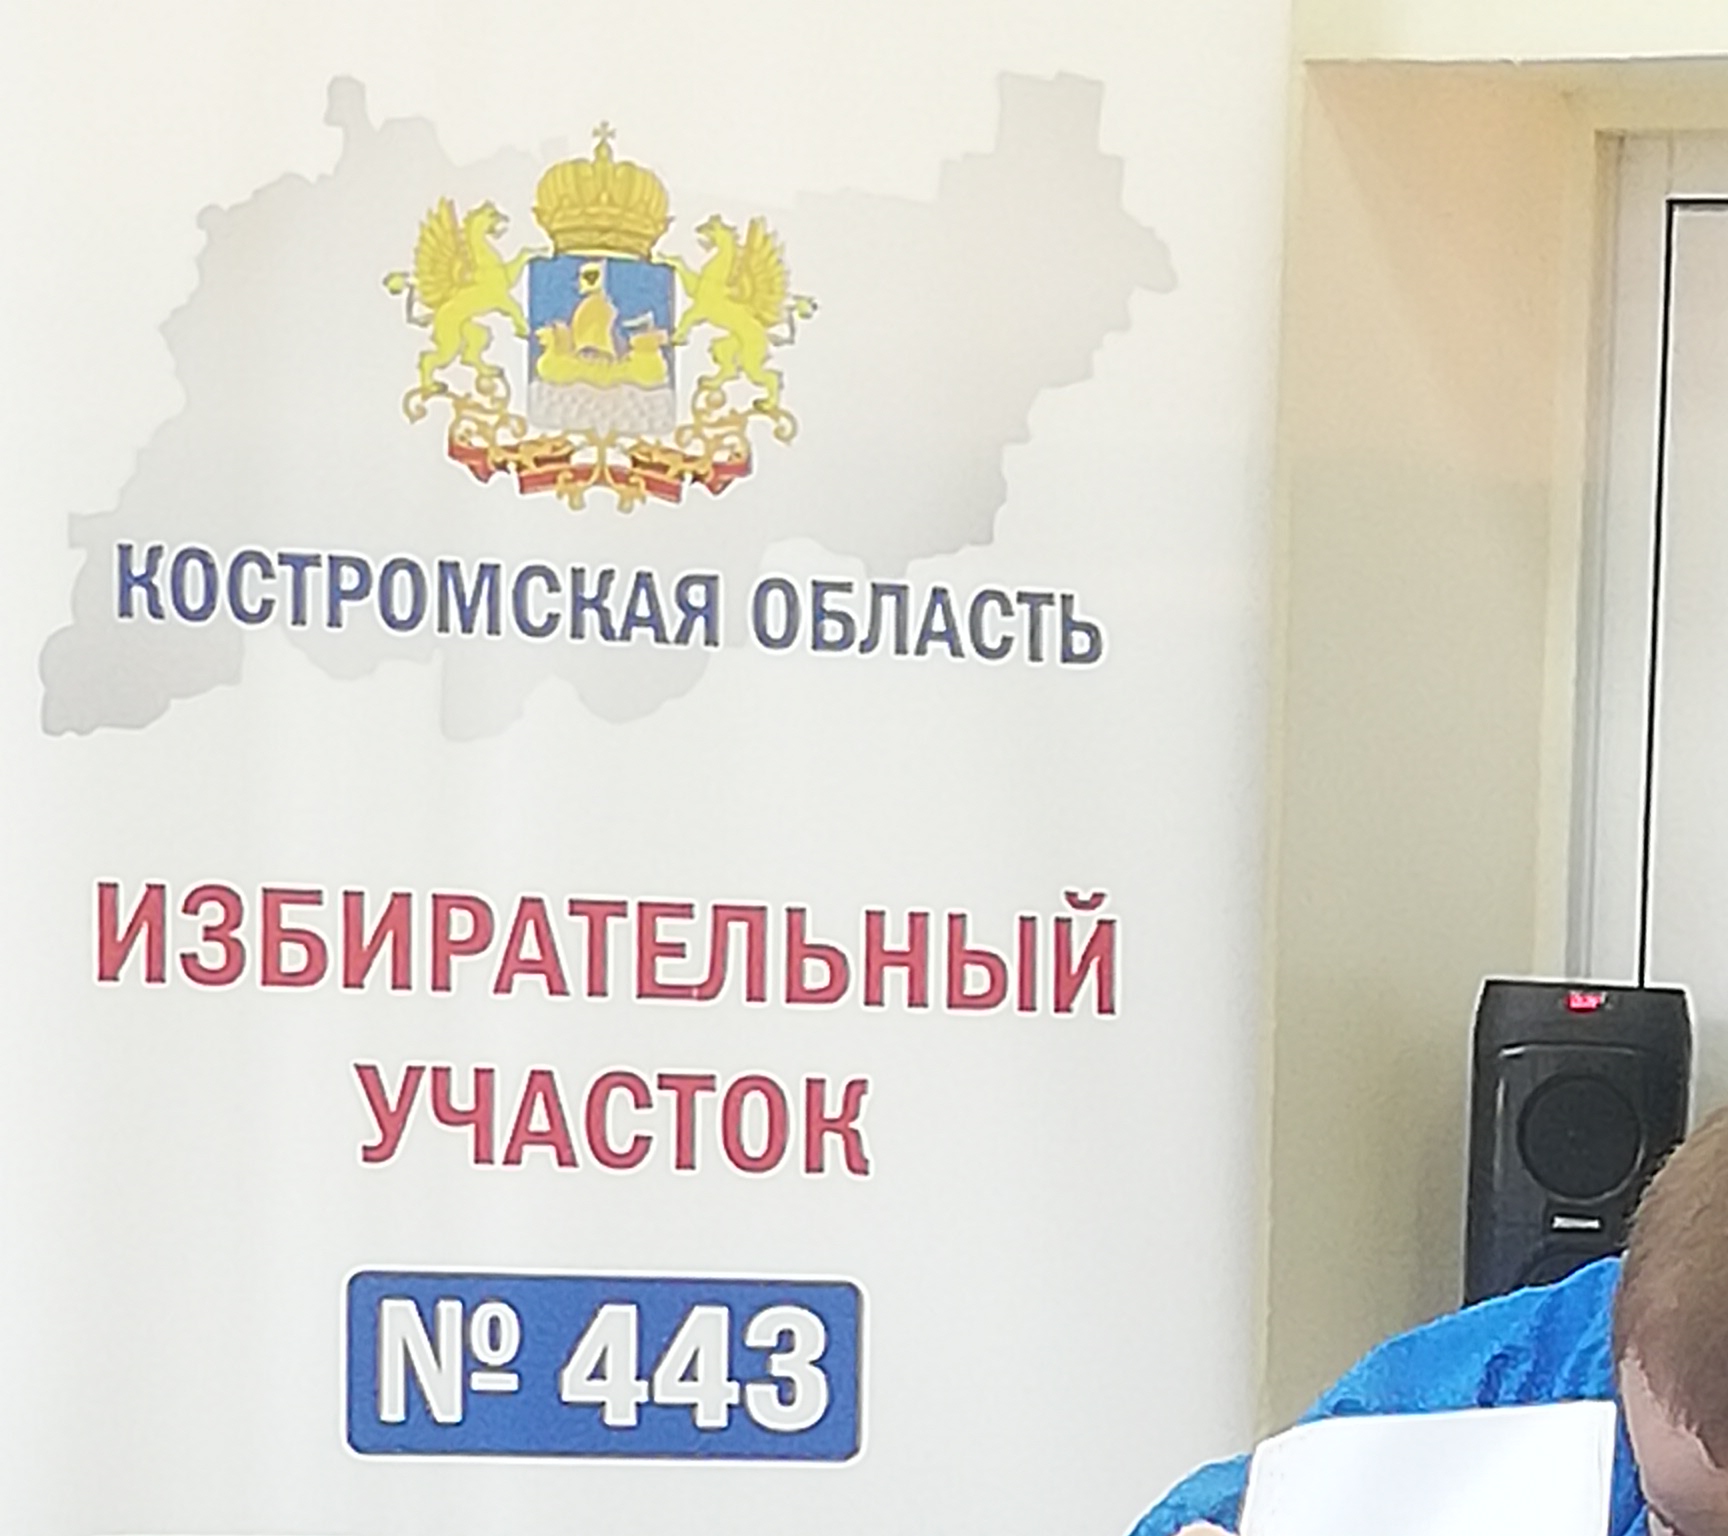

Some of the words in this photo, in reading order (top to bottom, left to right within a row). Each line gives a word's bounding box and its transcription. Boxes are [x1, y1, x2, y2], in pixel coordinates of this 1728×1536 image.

[115, 542, 721, 649] КОСТРОМСКАЯ
[752, 577, 1104, 667] ОБЛАСТЬ
[95, 881, 1119, 1016] ИЗБИРАТЕЛЬНЫЙ
[353, 1063, 872, 1177] УЧАСТОК
[377, 1298, 522, 1426] №
[560, 1303, 831, 1432] 443
